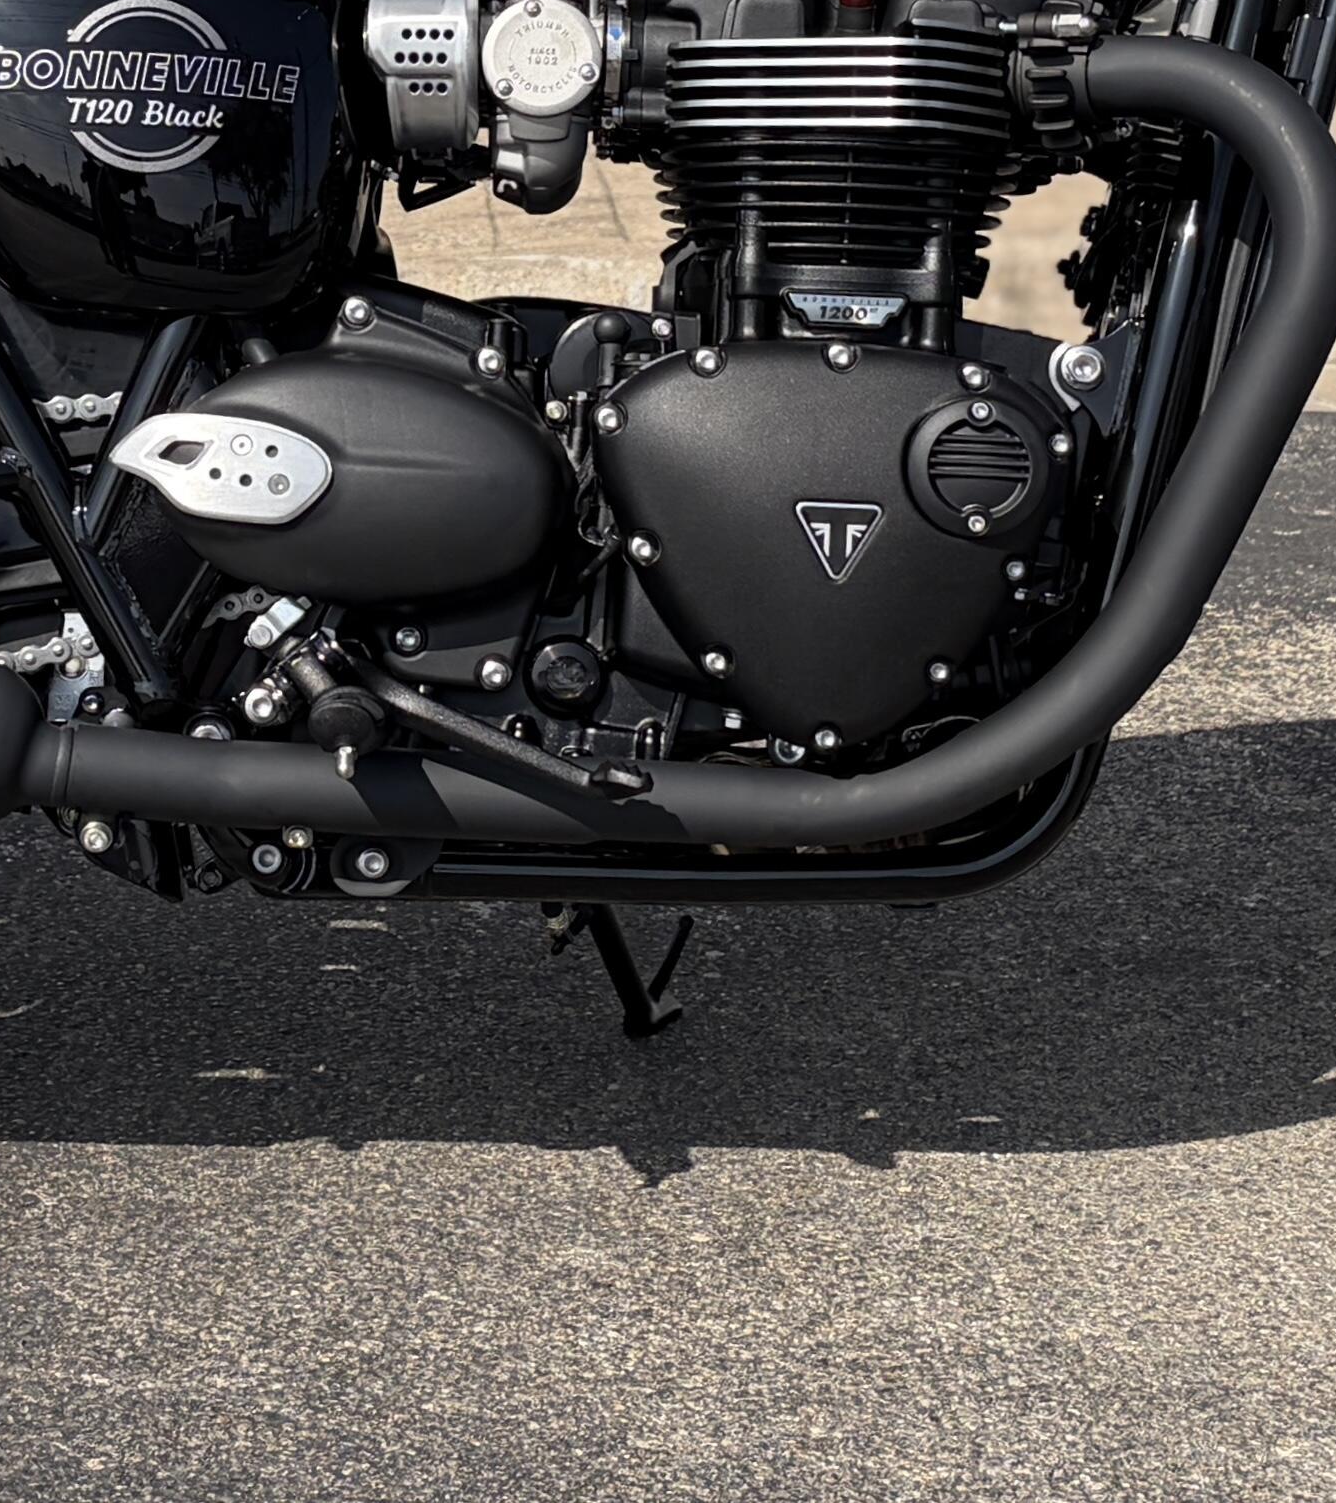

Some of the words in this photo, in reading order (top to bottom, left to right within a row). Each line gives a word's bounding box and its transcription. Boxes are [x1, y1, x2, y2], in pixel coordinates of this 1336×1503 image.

[515, 20, 569, 37] TRIUMPH
[508, 64, 577, 94] MOTORCYCLES
[67, 97, 133, 126] T120
[141, 99, 224, 129] Black
[819, 305, 868, 321] 1200
